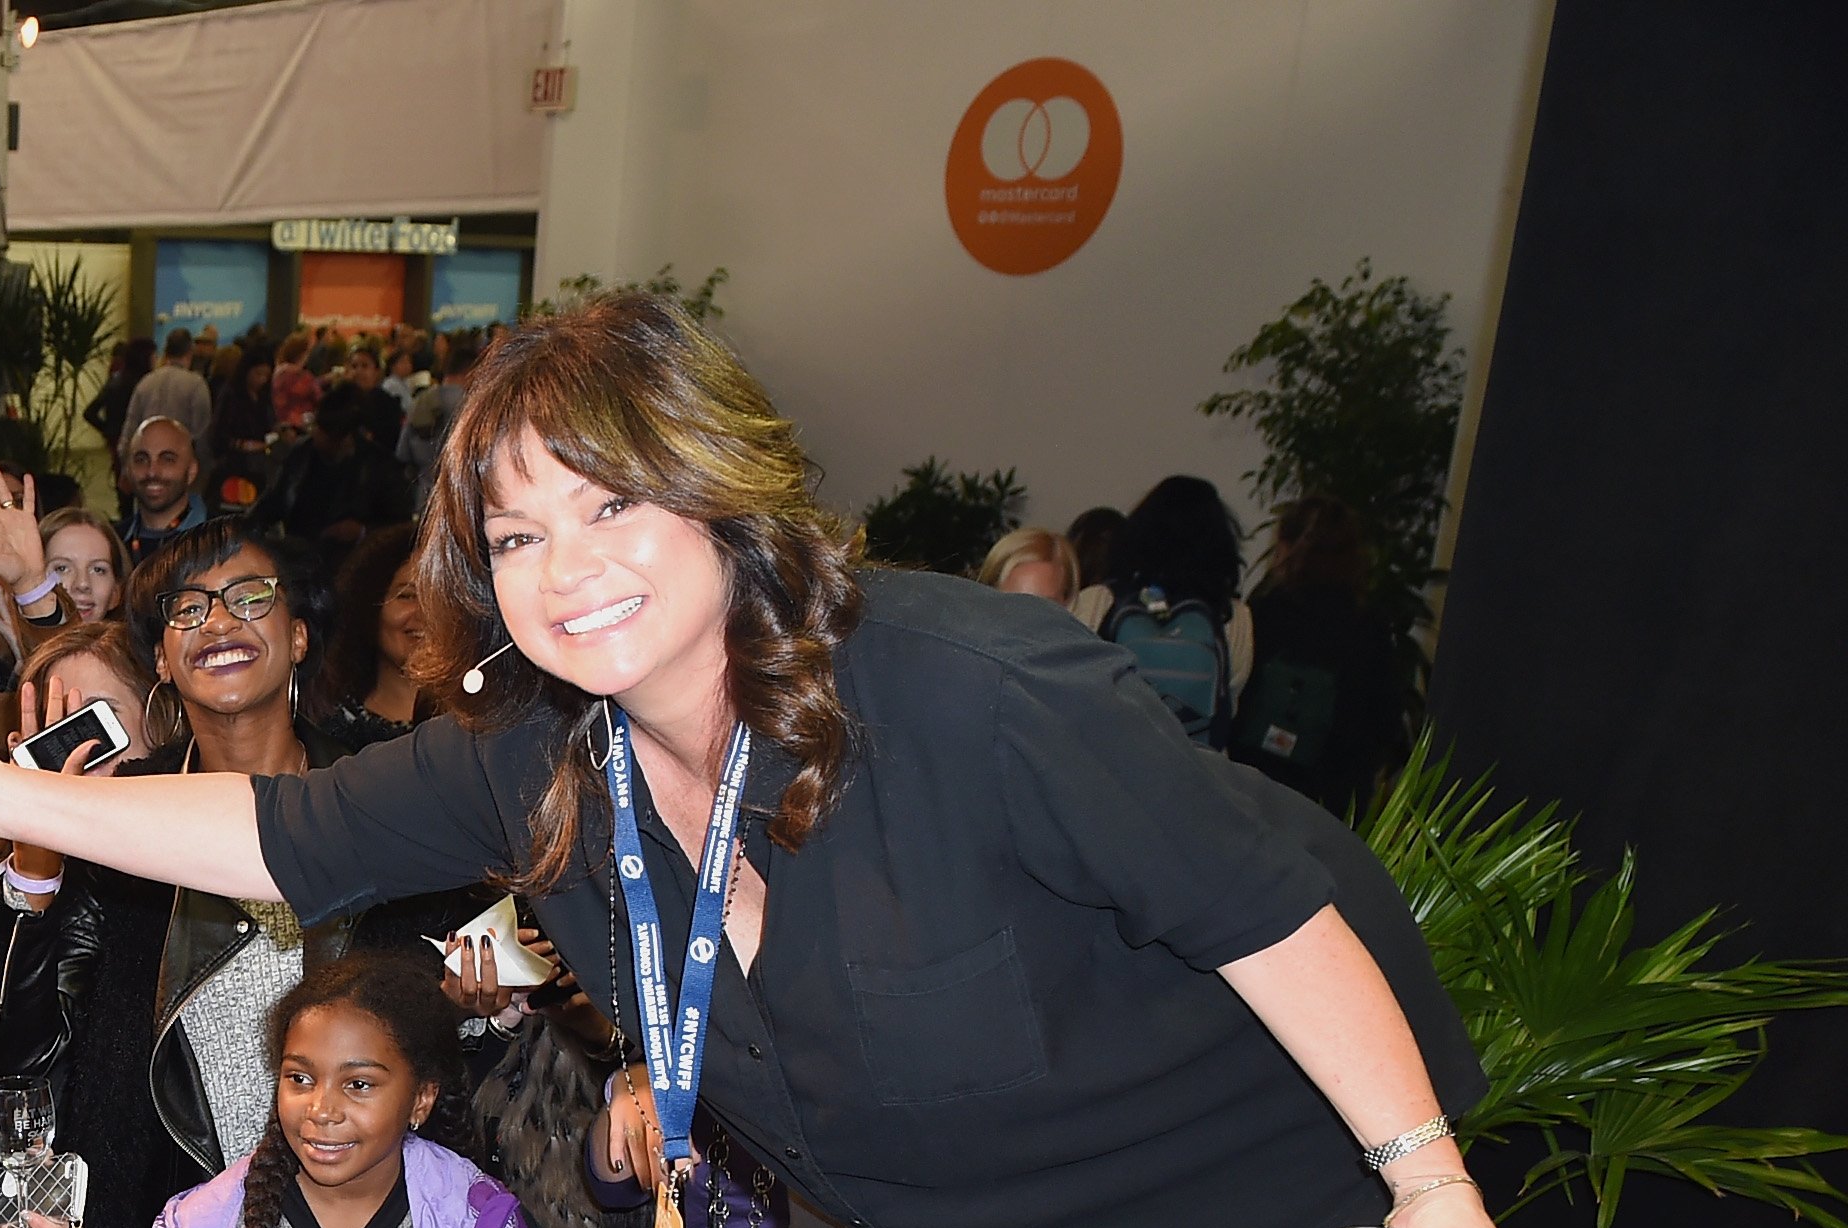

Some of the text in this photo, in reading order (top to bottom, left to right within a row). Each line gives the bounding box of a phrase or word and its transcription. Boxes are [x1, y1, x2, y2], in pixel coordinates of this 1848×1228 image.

[533, 69, 564, 102] EXIT
[979, 183, 1079, 202] mastercard
[272, 216, 460, 254] @TwitterFood
[613, 726, 629, 808] #NYCWFF
[730, 752, 749, 789] MOON
[720, 788, 738, 839] BREWING
[677, 1006, 700, 1091] #NYCWFF
[14, 1107, 36, 1121] EAT
[15, 1120, 30, 1131] BE
